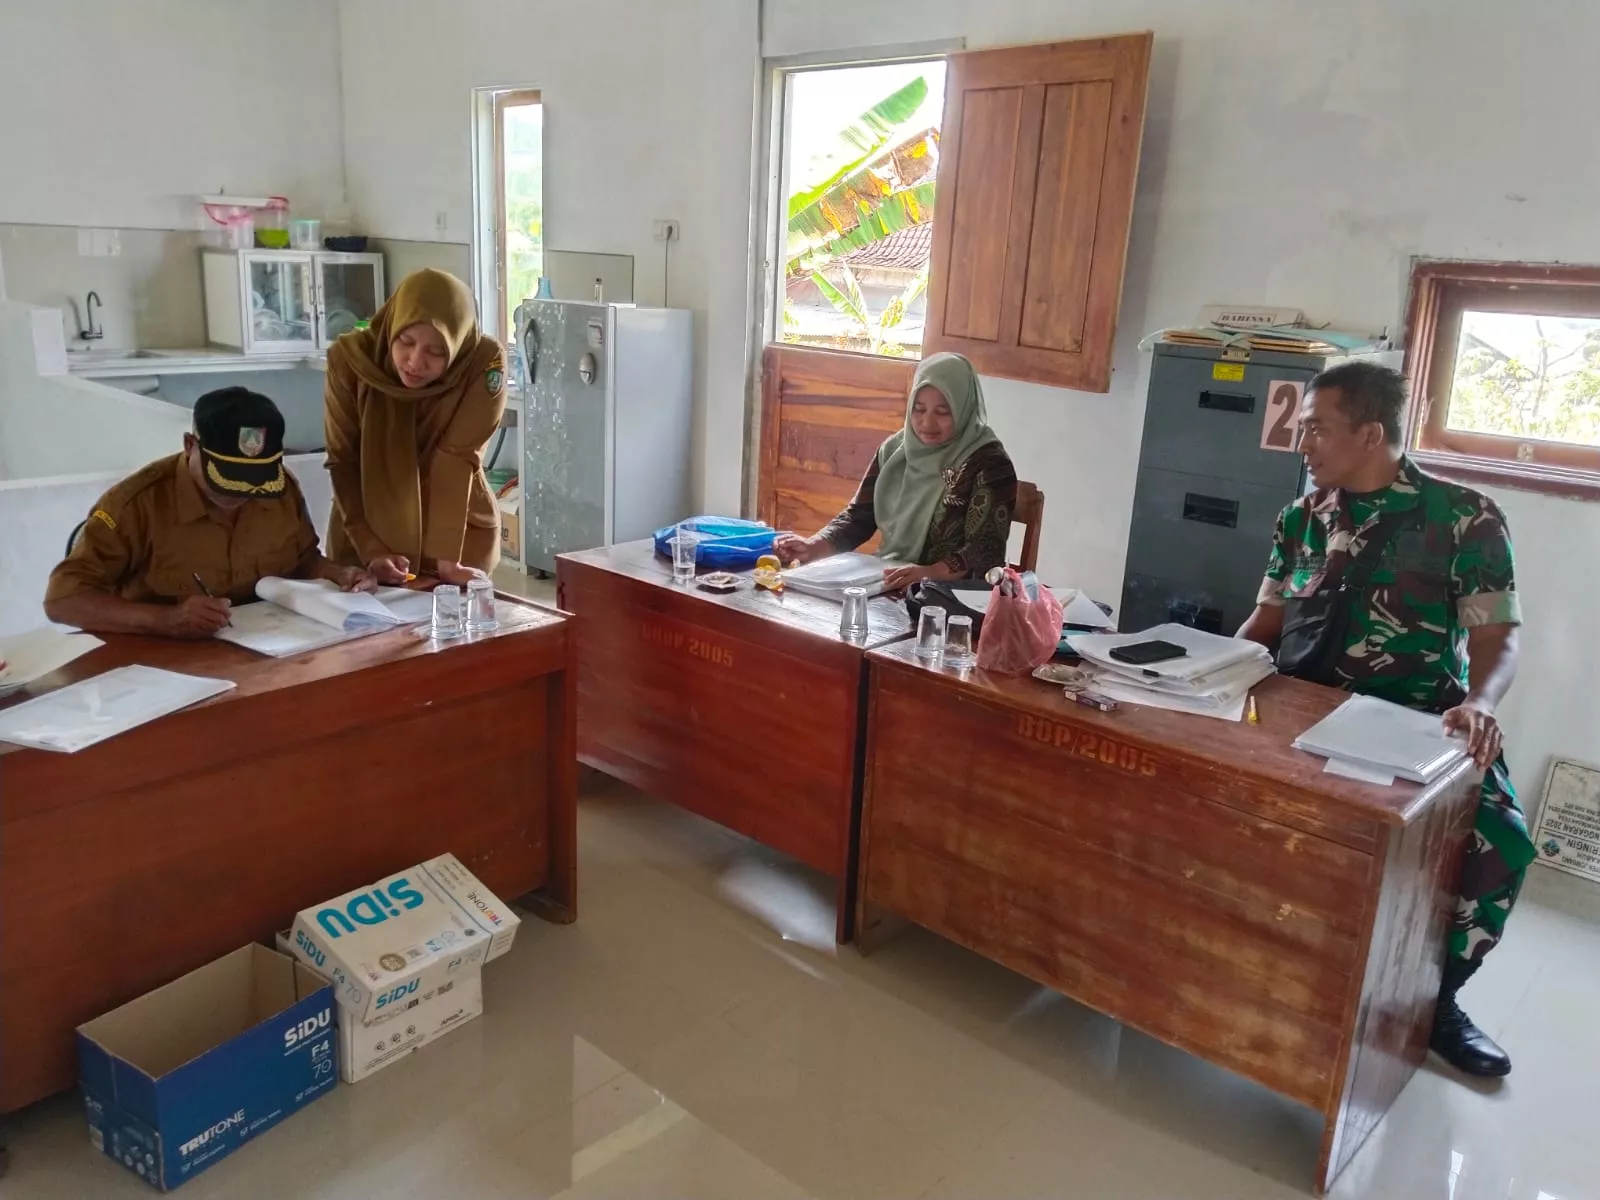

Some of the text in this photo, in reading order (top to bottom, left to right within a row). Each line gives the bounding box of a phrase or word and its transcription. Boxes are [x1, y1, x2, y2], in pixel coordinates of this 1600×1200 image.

[1266, 384, 1298, 448] 2
[1567, 839, 1600, 855] RINGIN
[467, 891, 502, 926] TRUTONE
[312, 1040, 329, 1057] F4
[179, 1108, 246, 1156] TRUTONE
